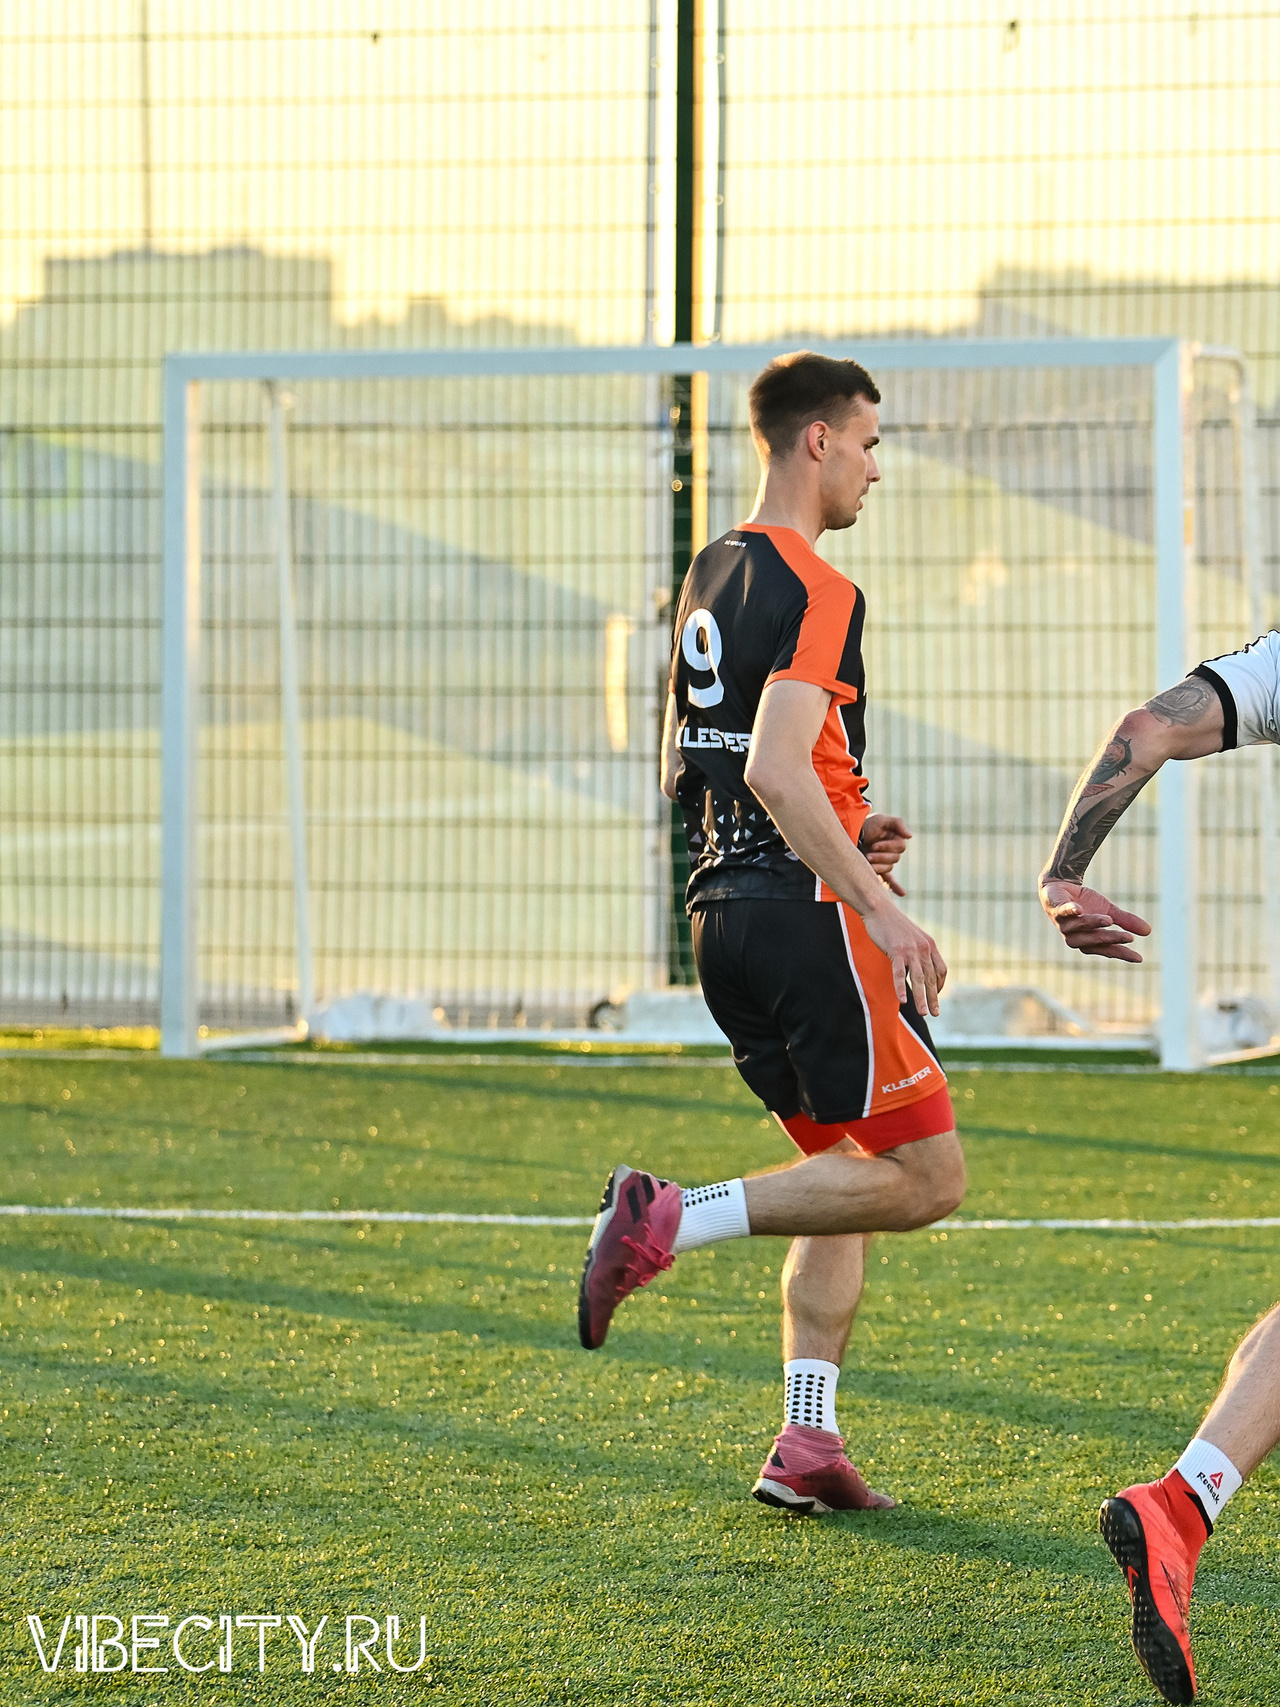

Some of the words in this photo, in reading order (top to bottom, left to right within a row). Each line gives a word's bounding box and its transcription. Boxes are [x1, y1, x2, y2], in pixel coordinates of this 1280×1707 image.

[682, 608, 725, 709] 9
[675, 726, 752, 752] LESER
[881, 1066, 932, 1093] KLESTER
